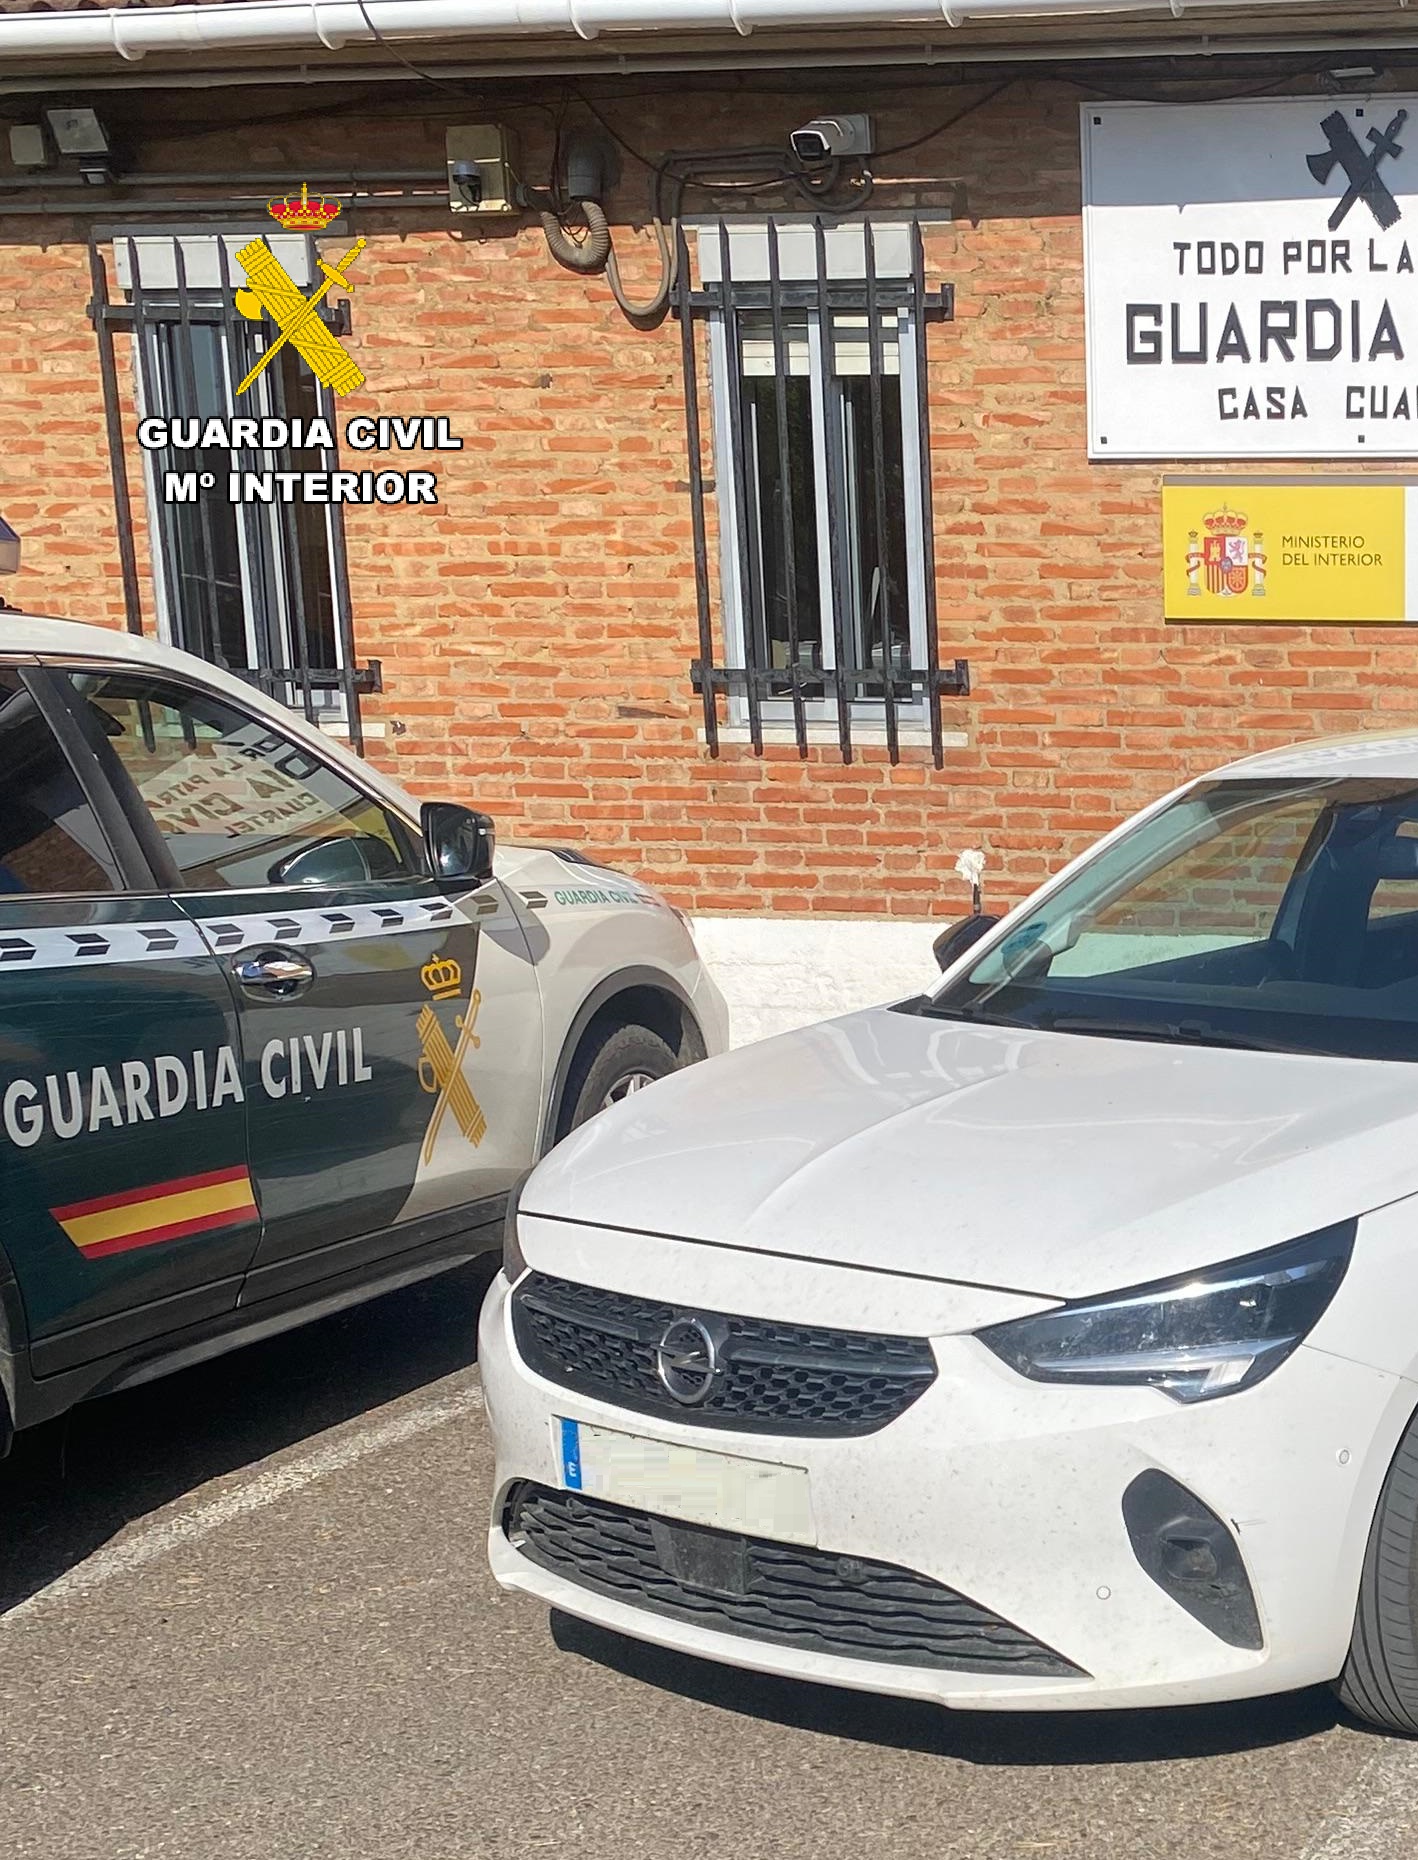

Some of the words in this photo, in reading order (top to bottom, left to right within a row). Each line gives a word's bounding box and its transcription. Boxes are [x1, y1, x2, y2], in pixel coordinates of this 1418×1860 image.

[1174, 241, 1263, 275] TODO
[1283, 240, 1352, 274] POR
[1368, 239, 1413, 273] LA
[1126, 299, 1404, 364] GUARDIA
[1218, 387, 1307, 420] CASA
[1281, 535, 1366, 550] MINISTERIO
[1282, 553, 1310, 568] DEL
[1313, 553, 1384, 568] INTERIOR
[554, 889, 611, 906] GUARDIA
[3, 1045, 245, 1148] GUARDIA
[260, 1027, 373, 1099] CIVIL
